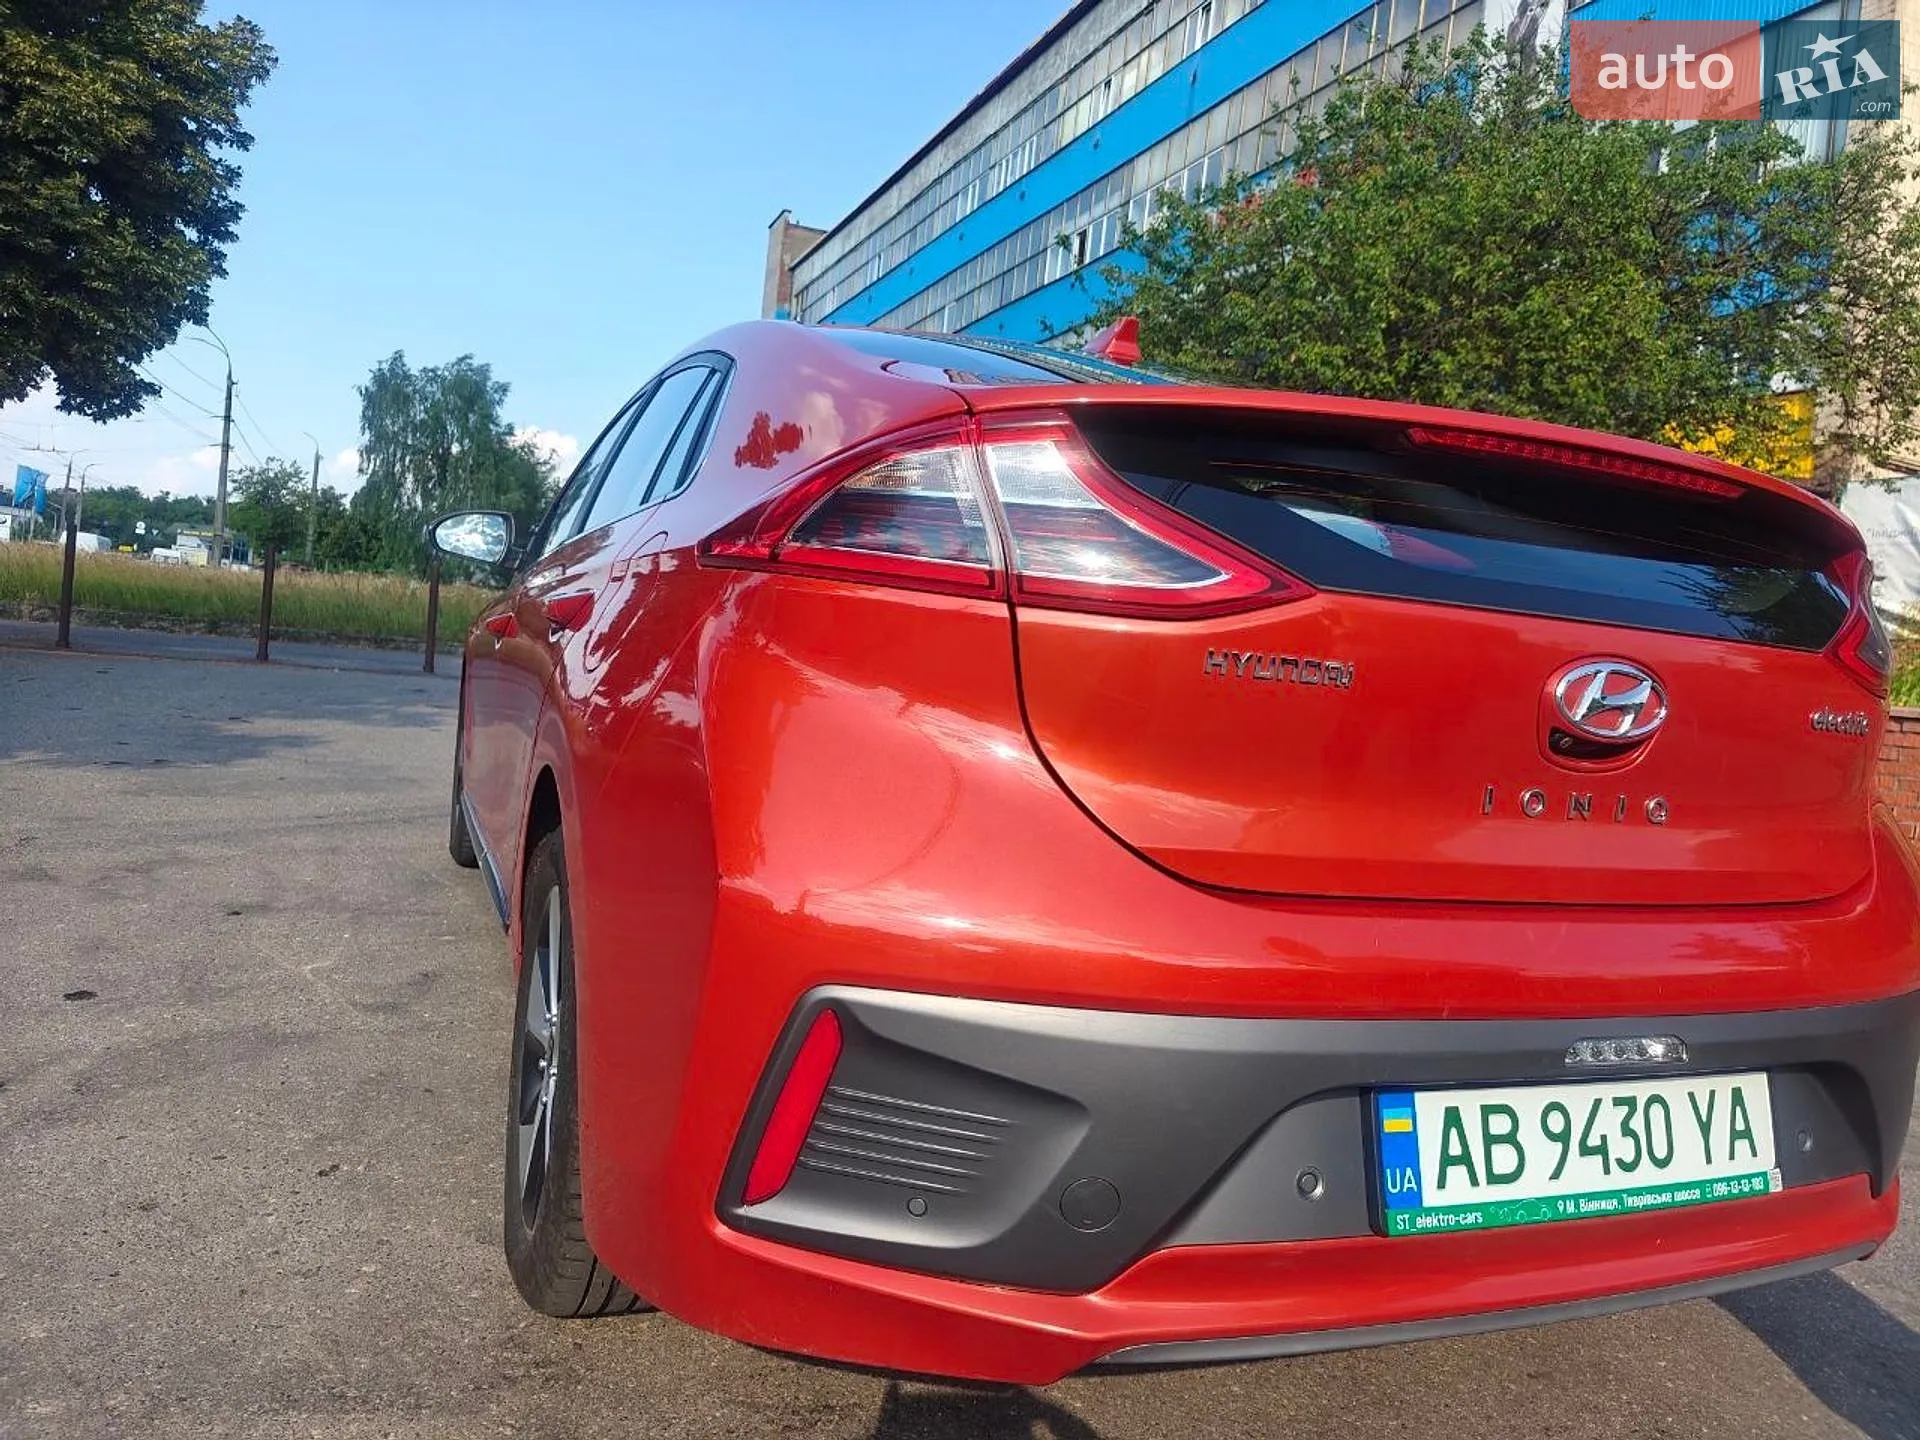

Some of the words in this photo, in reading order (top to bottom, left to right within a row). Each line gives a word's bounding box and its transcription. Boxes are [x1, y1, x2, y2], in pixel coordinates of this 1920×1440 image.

[1204, 648, 1354, 688] HYUNDAI
[1810, 707, 1869, 736] electric
[1481, 785, 1670, 825] IONIQ
[1436, 1104, 1526, 1190] AB
[1540, 1093, 1674, 1181] 9430
[1687, 1086, 1758, 1165] YA
[1386, 1167, 1418, 1194] UA
[1396, 1211, 1484, 1232] ST_elektro-cars
